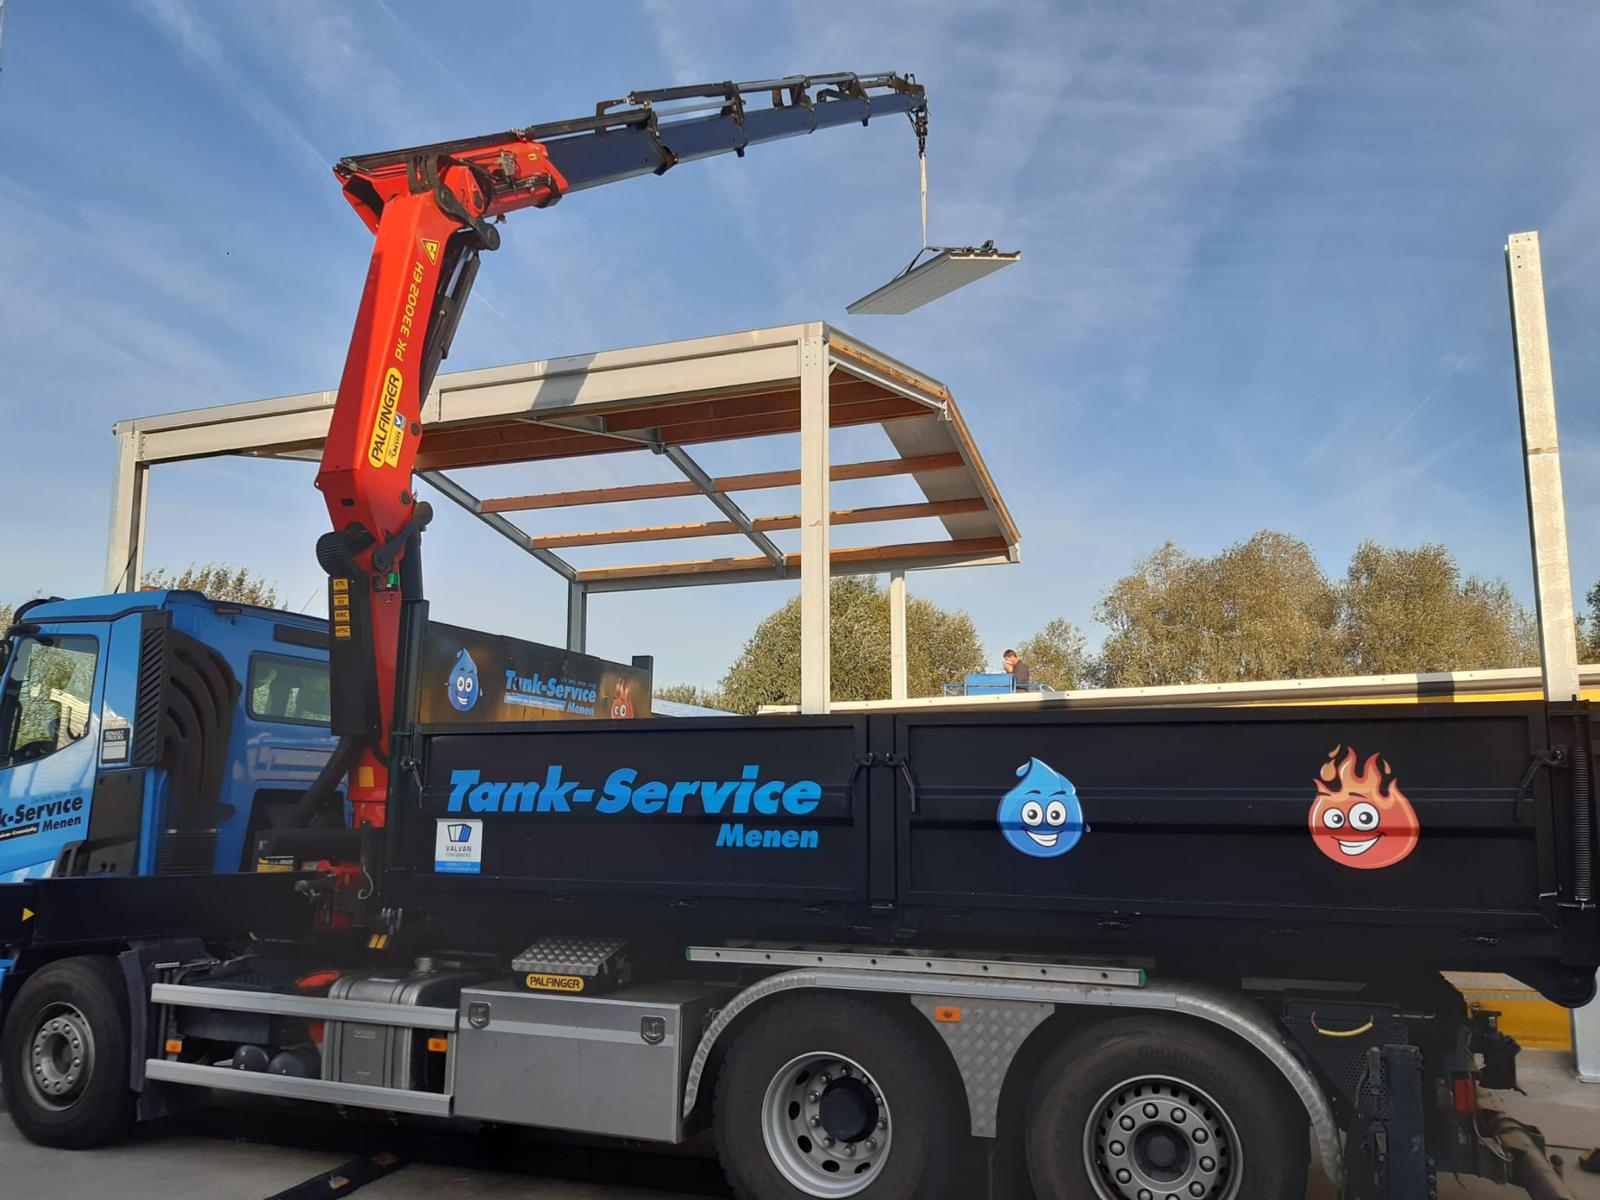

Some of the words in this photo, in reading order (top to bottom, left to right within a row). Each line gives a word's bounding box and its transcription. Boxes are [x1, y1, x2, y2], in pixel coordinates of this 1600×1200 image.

[394, 337, 407, 362] PK
[371, 373, 401, 462] PALFINGER
[567, 701, 595, 716] Menen
[447, 764, 823, 816] Tank-Service
[42, 816, 82, 832] Menen
[716, 822, 819, 849] Menen
[529, 976, 580, 989] PALFINGER
